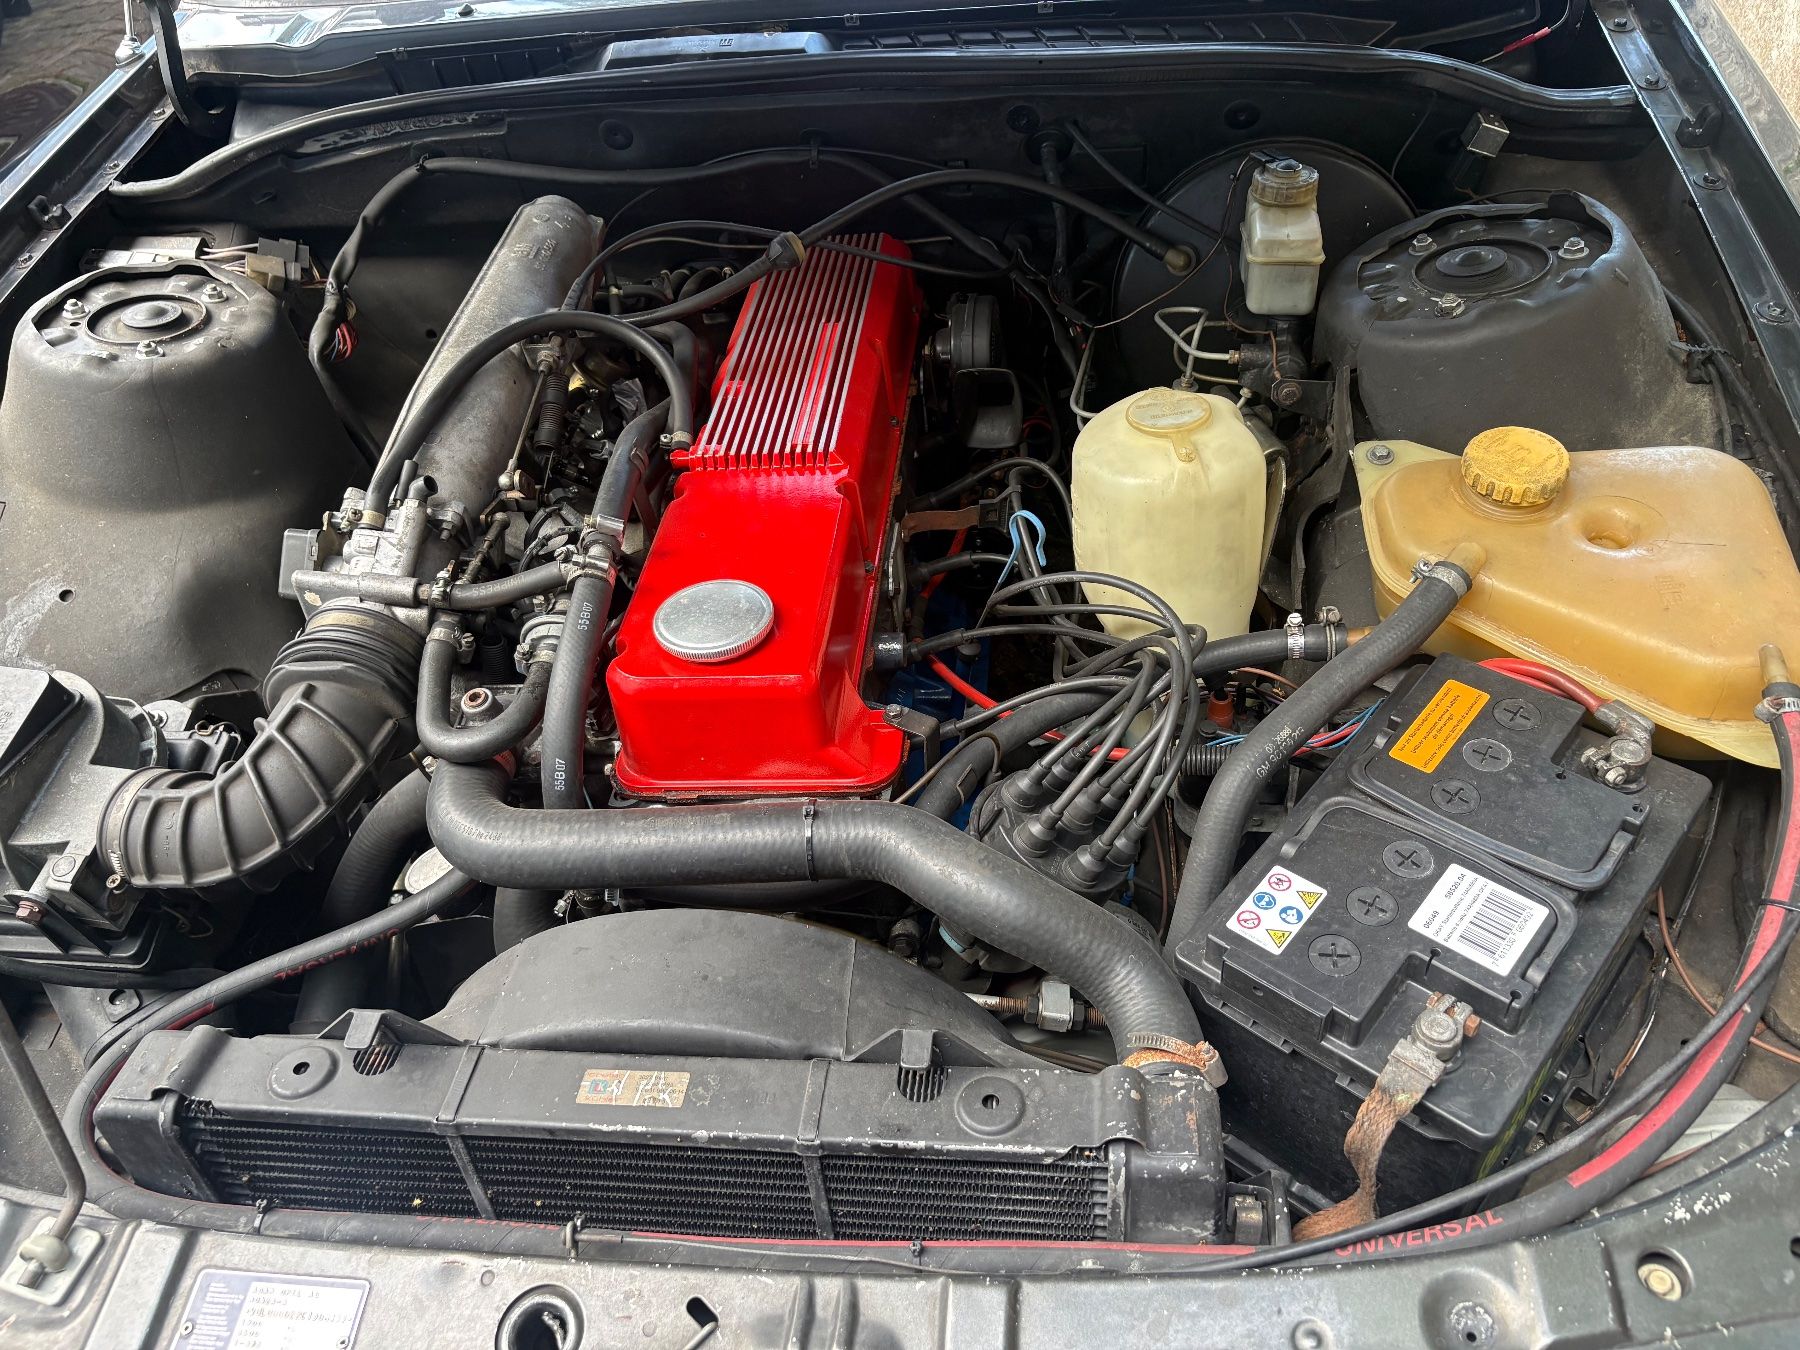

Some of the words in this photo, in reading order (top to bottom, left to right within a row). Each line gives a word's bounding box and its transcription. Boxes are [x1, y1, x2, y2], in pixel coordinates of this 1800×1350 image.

[472, 575, 524, 597] UNIPRESS
[577, 601, 593, 631] 55B07
[554, 757, 566, 791] 55B07
